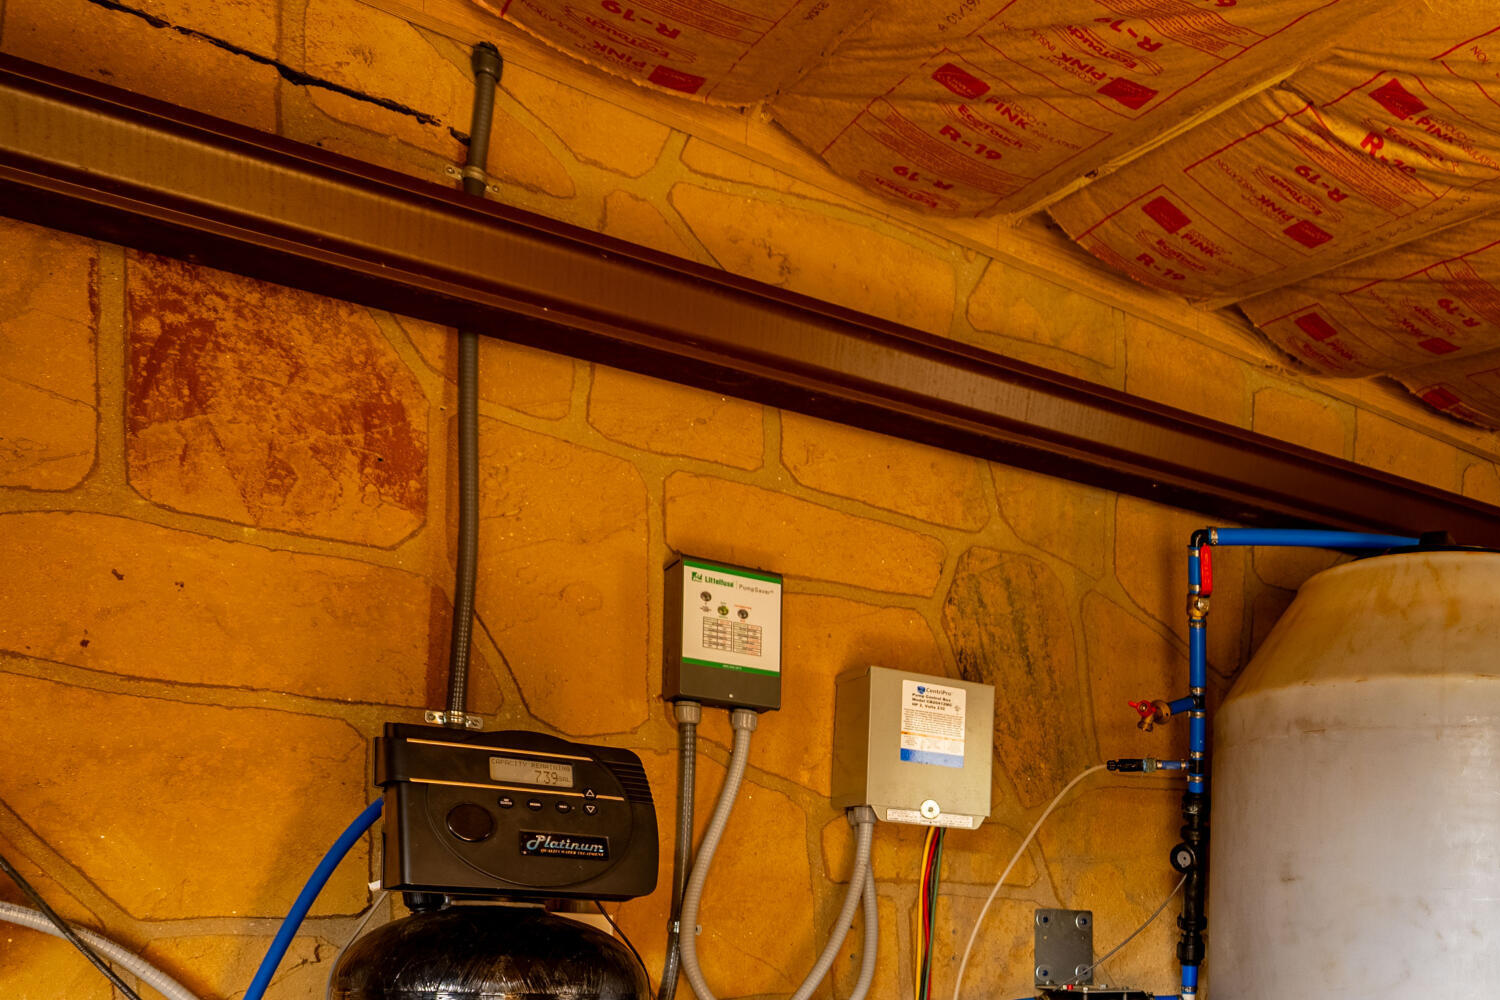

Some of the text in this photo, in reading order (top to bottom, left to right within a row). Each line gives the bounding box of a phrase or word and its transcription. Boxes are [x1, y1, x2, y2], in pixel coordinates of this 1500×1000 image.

[592, 40, 647, 69] PINK
[1057, 52, 1108, 81] PINK
[986, 96, 1032, 130] PINK
[939, 125, 1002, 160] R-19
[1295, 165, 1349, 203] R-19
[1181, 232, 1216, 257] PINK
[1136, 253, 1186, 281] R-19
[535, 770, 558, 785] 739
[527, 835, 605, 853] Platinum
